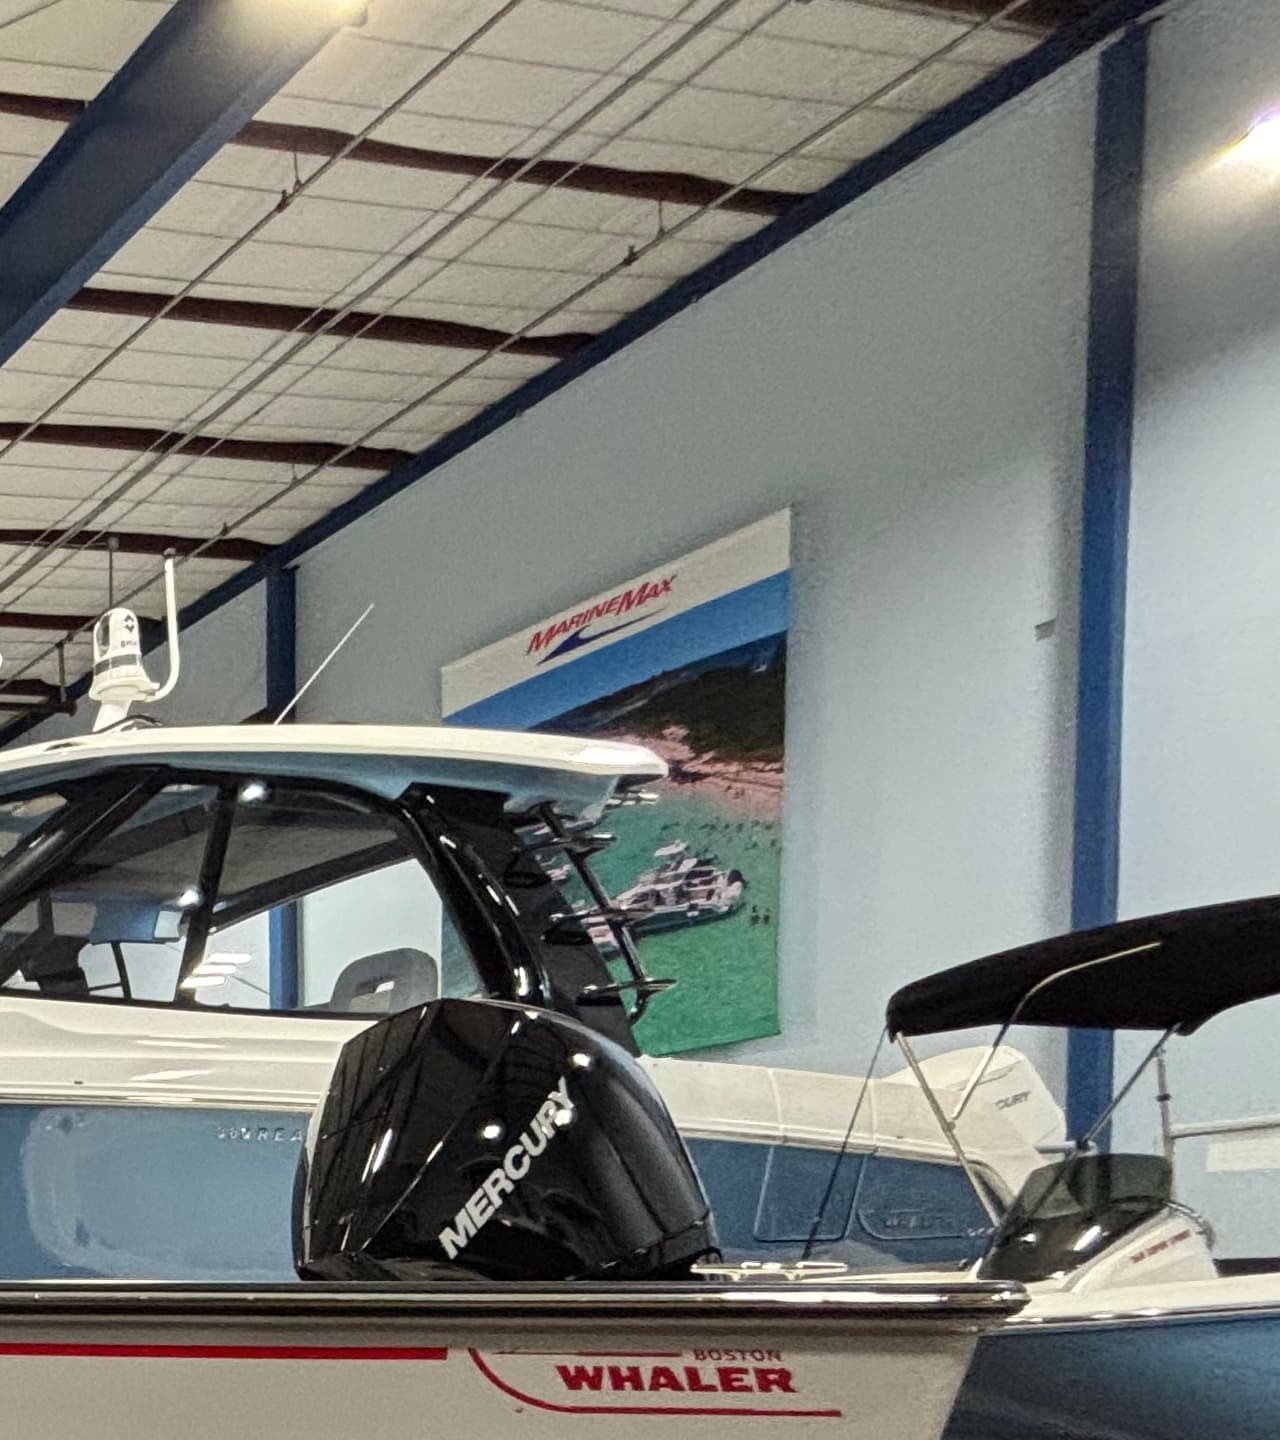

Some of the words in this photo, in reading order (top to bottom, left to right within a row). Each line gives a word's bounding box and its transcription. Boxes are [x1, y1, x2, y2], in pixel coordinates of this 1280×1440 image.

[438, 1075, 575, 1260] MERCURY
[693, 1349, 783, 1362] BOSTON
[555, 1365, 799, 1394] WHALER
